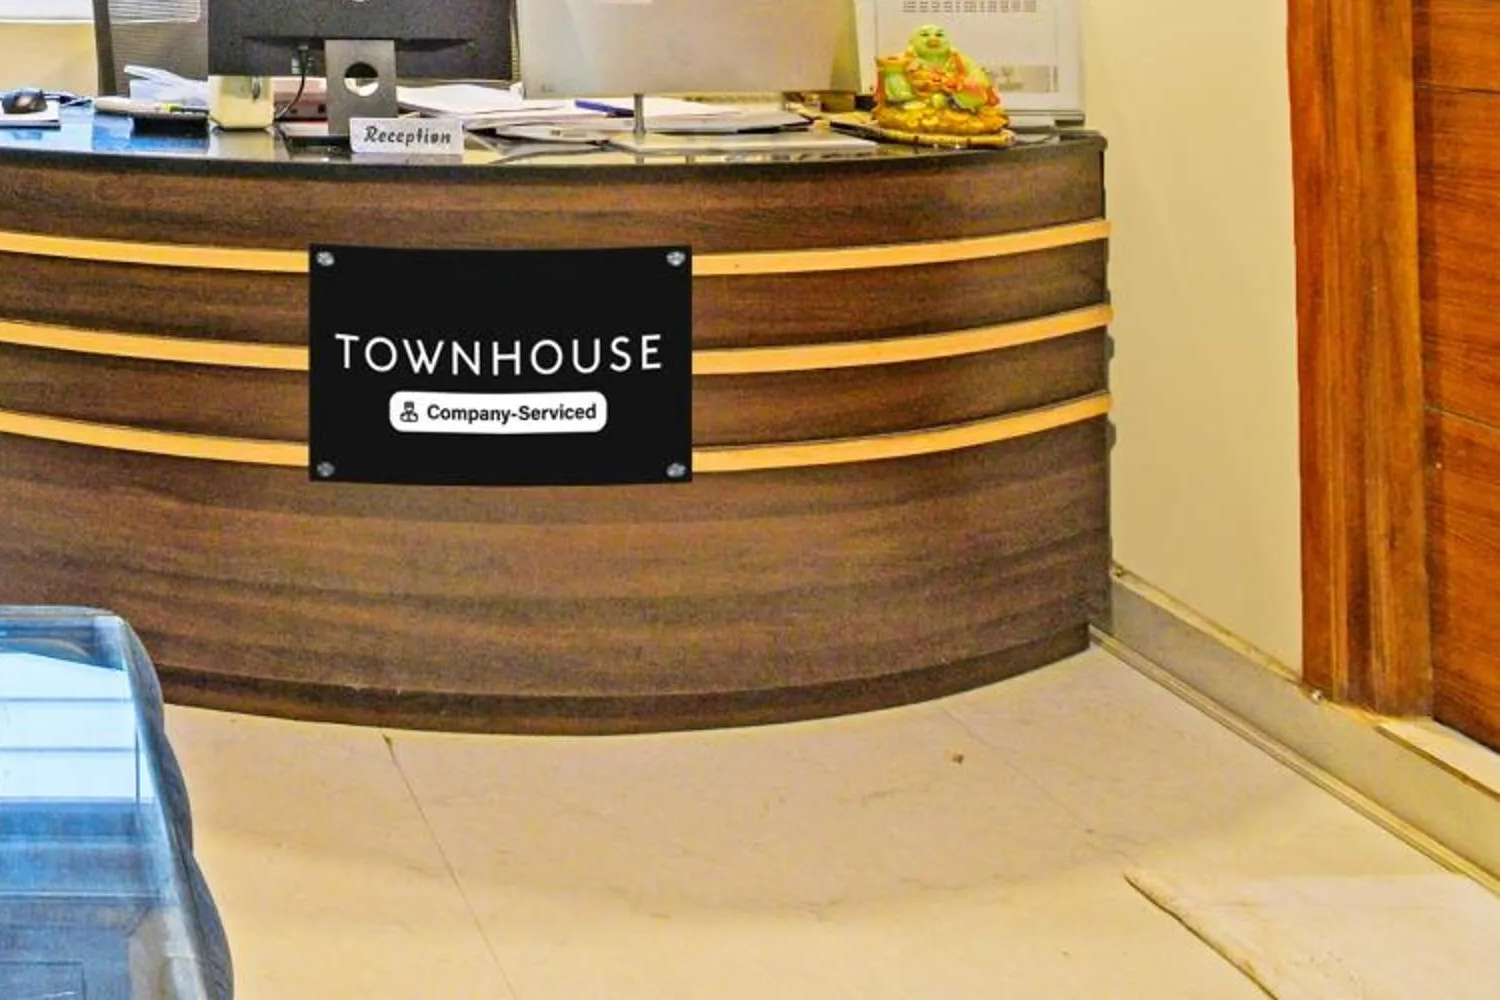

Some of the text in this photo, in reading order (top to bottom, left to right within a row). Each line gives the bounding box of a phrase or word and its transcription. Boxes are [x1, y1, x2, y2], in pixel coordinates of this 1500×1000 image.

[363, 124, 453, 147] Reception
[334, 333, 663, 377] TOWNHOUSE
[426, 402, 598, 426] Company-Serviced
